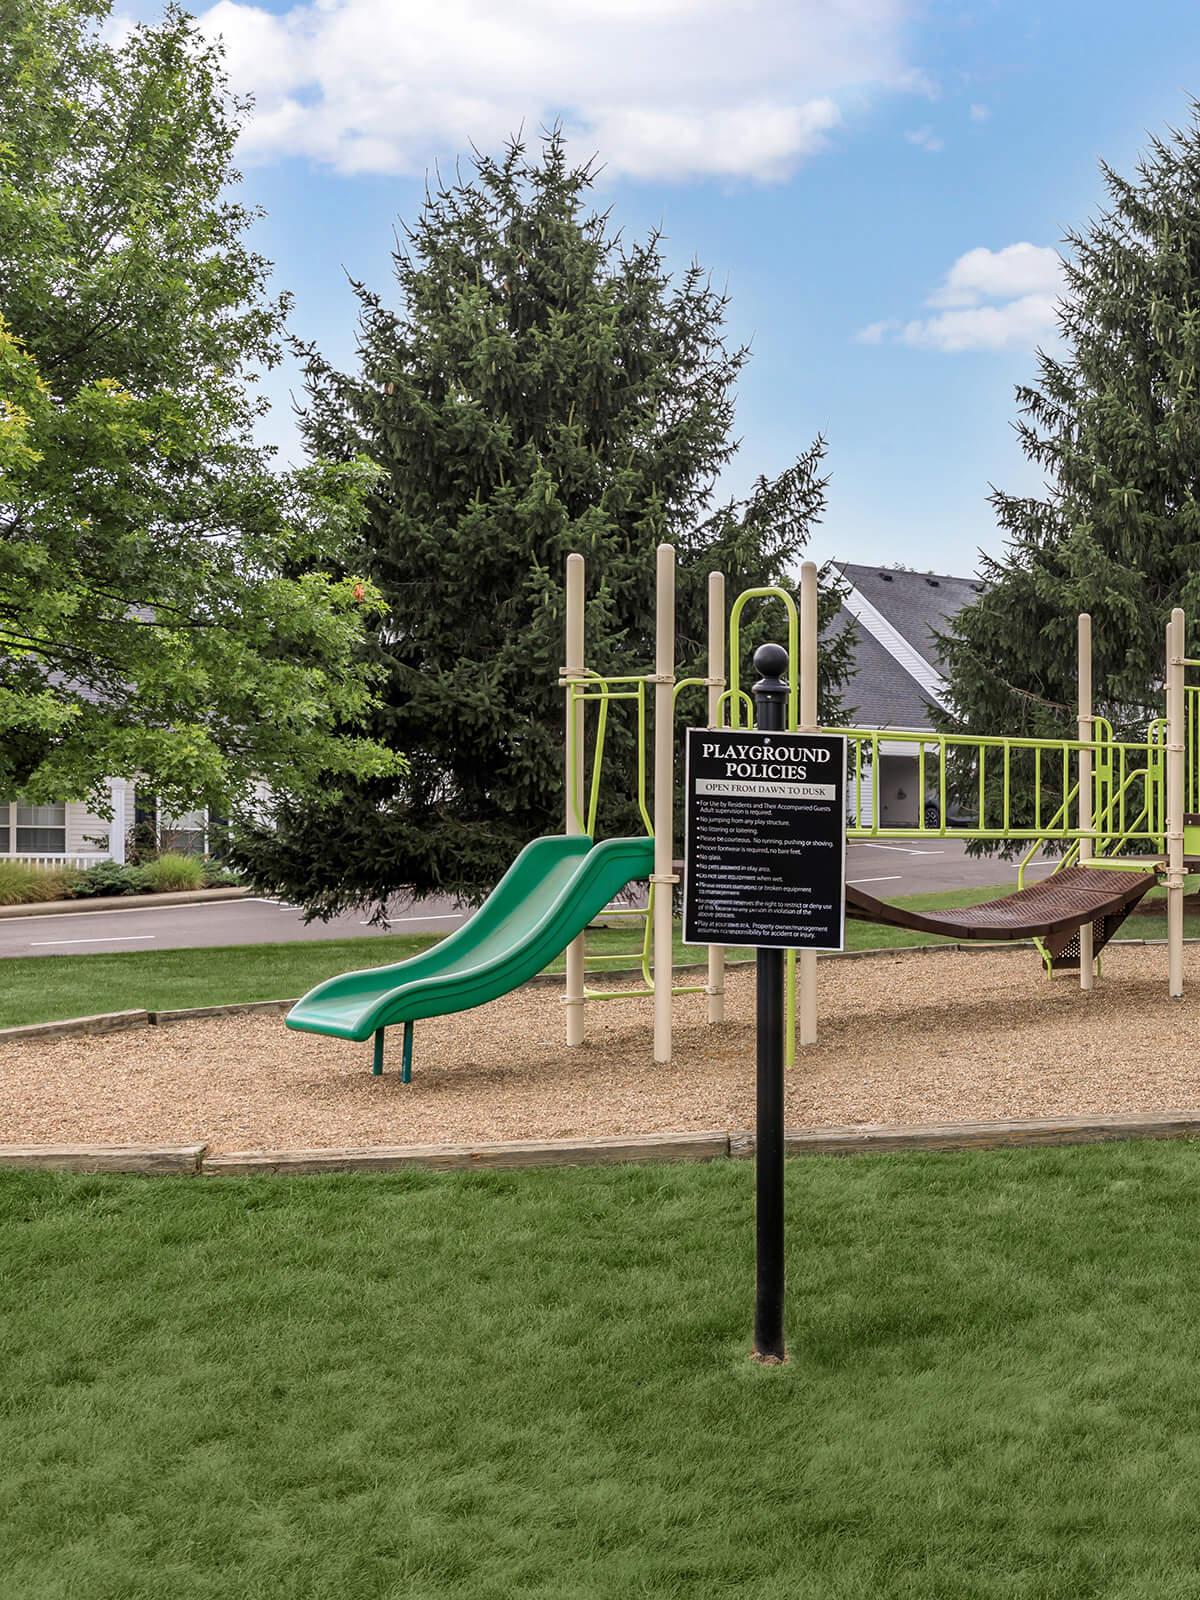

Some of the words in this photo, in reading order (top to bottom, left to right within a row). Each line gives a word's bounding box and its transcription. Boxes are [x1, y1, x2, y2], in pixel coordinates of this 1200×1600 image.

[702, 743, 831, 763] PLAYGROUND
[725, 762, 807, 780] POLICIES
[705, 783, 729, 792] OPEN
[731, 784, 757, 793] FROM
[758, 785, 786, 794] DAWN
[787, 786, 801, 795] TO
[802, 787, 826, 796] DUSK
